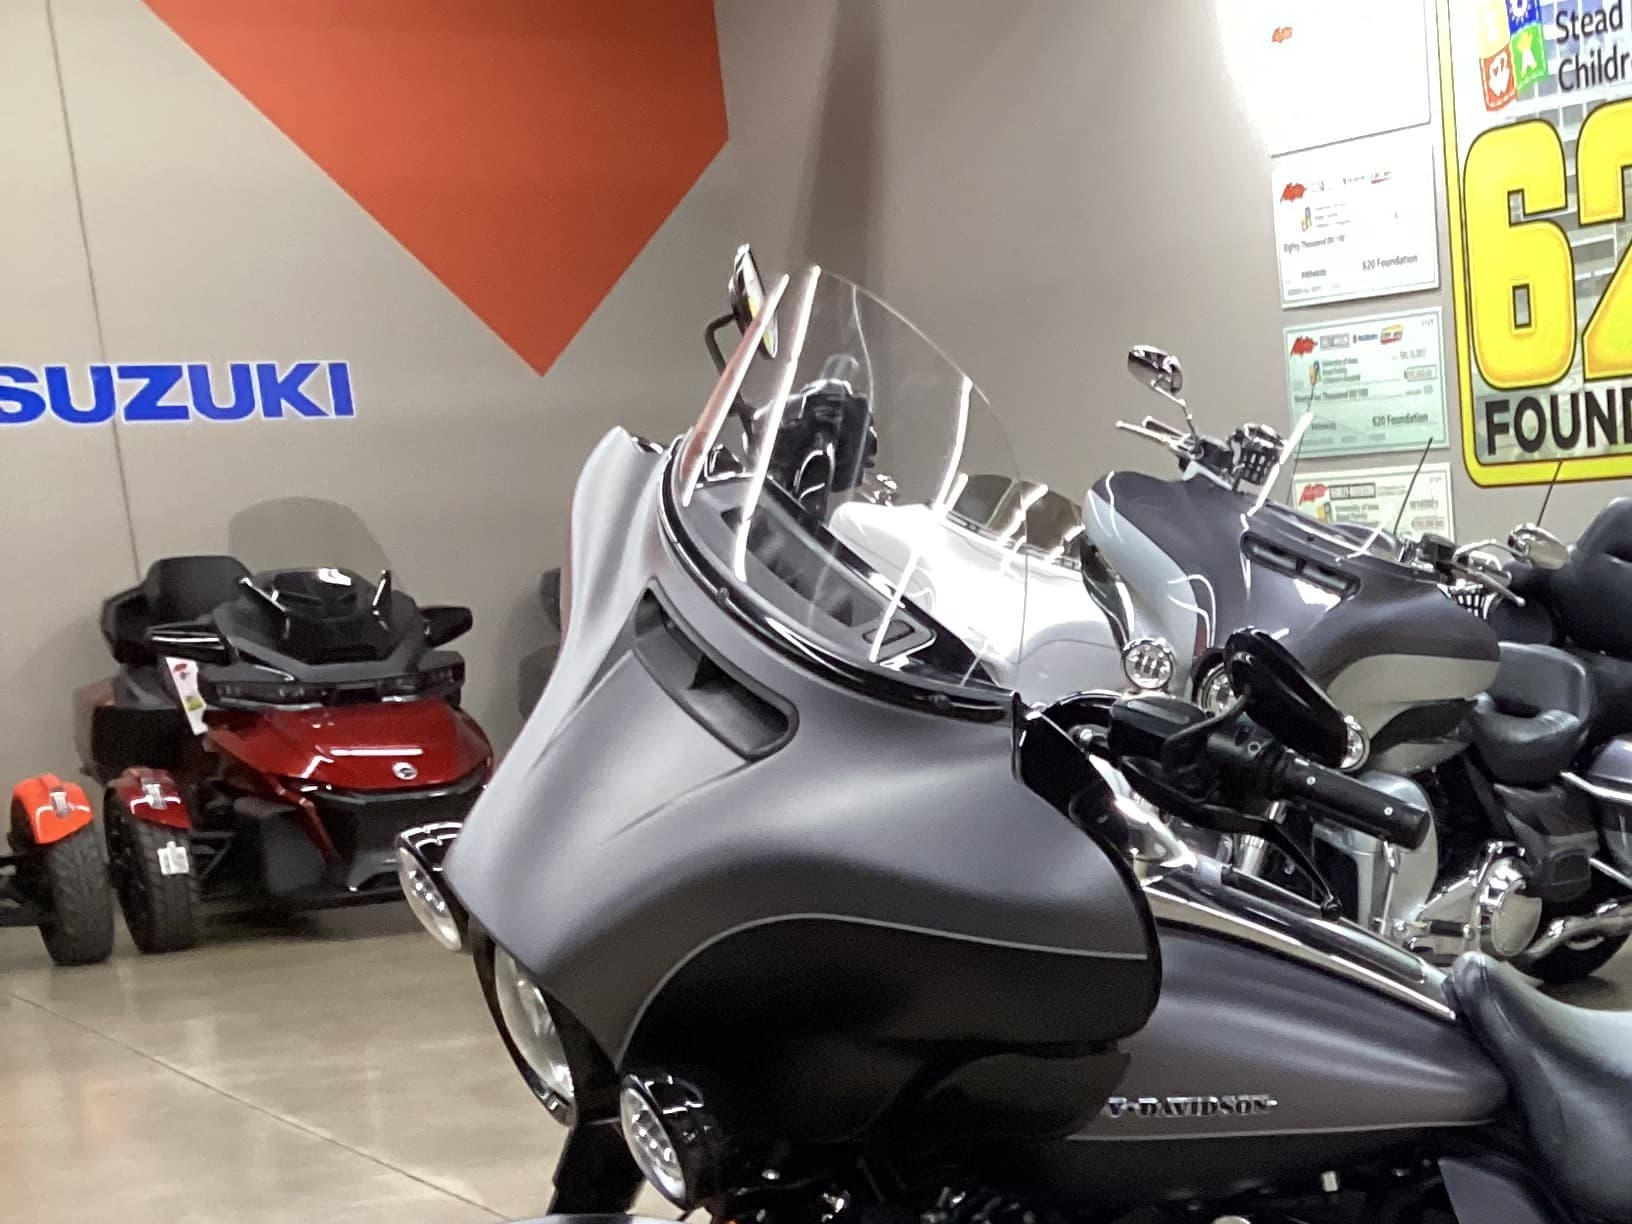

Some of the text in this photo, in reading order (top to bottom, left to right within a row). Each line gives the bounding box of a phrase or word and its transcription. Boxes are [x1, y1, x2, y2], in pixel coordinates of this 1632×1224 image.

[1555, 1, 1624, 45] Stead
[1377, 255, 1418, 268] Foundation
[0, 363, 355, 424] SUZUKI
[1371, 412, 1429, 427] 620 Foundation
